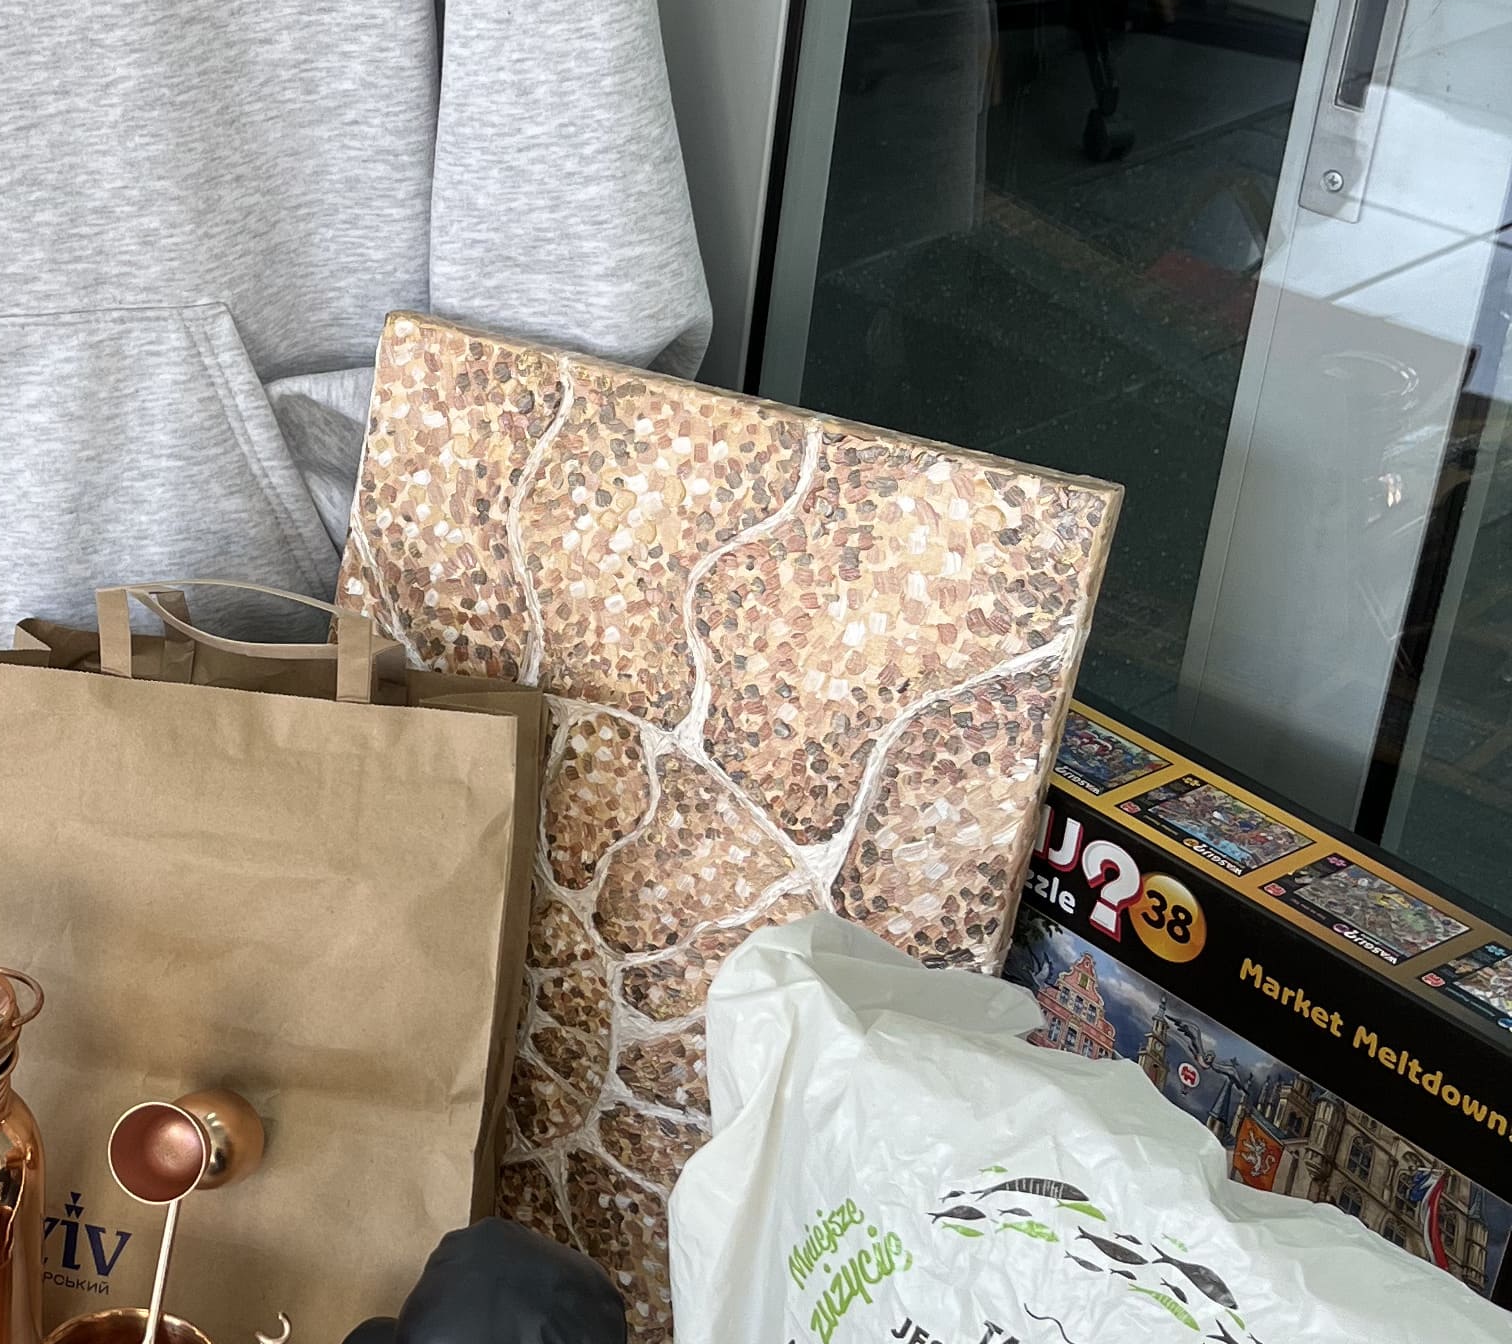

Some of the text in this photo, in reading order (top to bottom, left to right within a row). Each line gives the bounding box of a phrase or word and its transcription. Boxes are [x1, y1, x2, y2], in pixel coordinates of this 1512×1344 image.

[1141, 889, 1193, 944] 38
[1239, 957, 1512, 1143] Market Meltdown
[789, 1198, 865, 1290] Mniejsze
